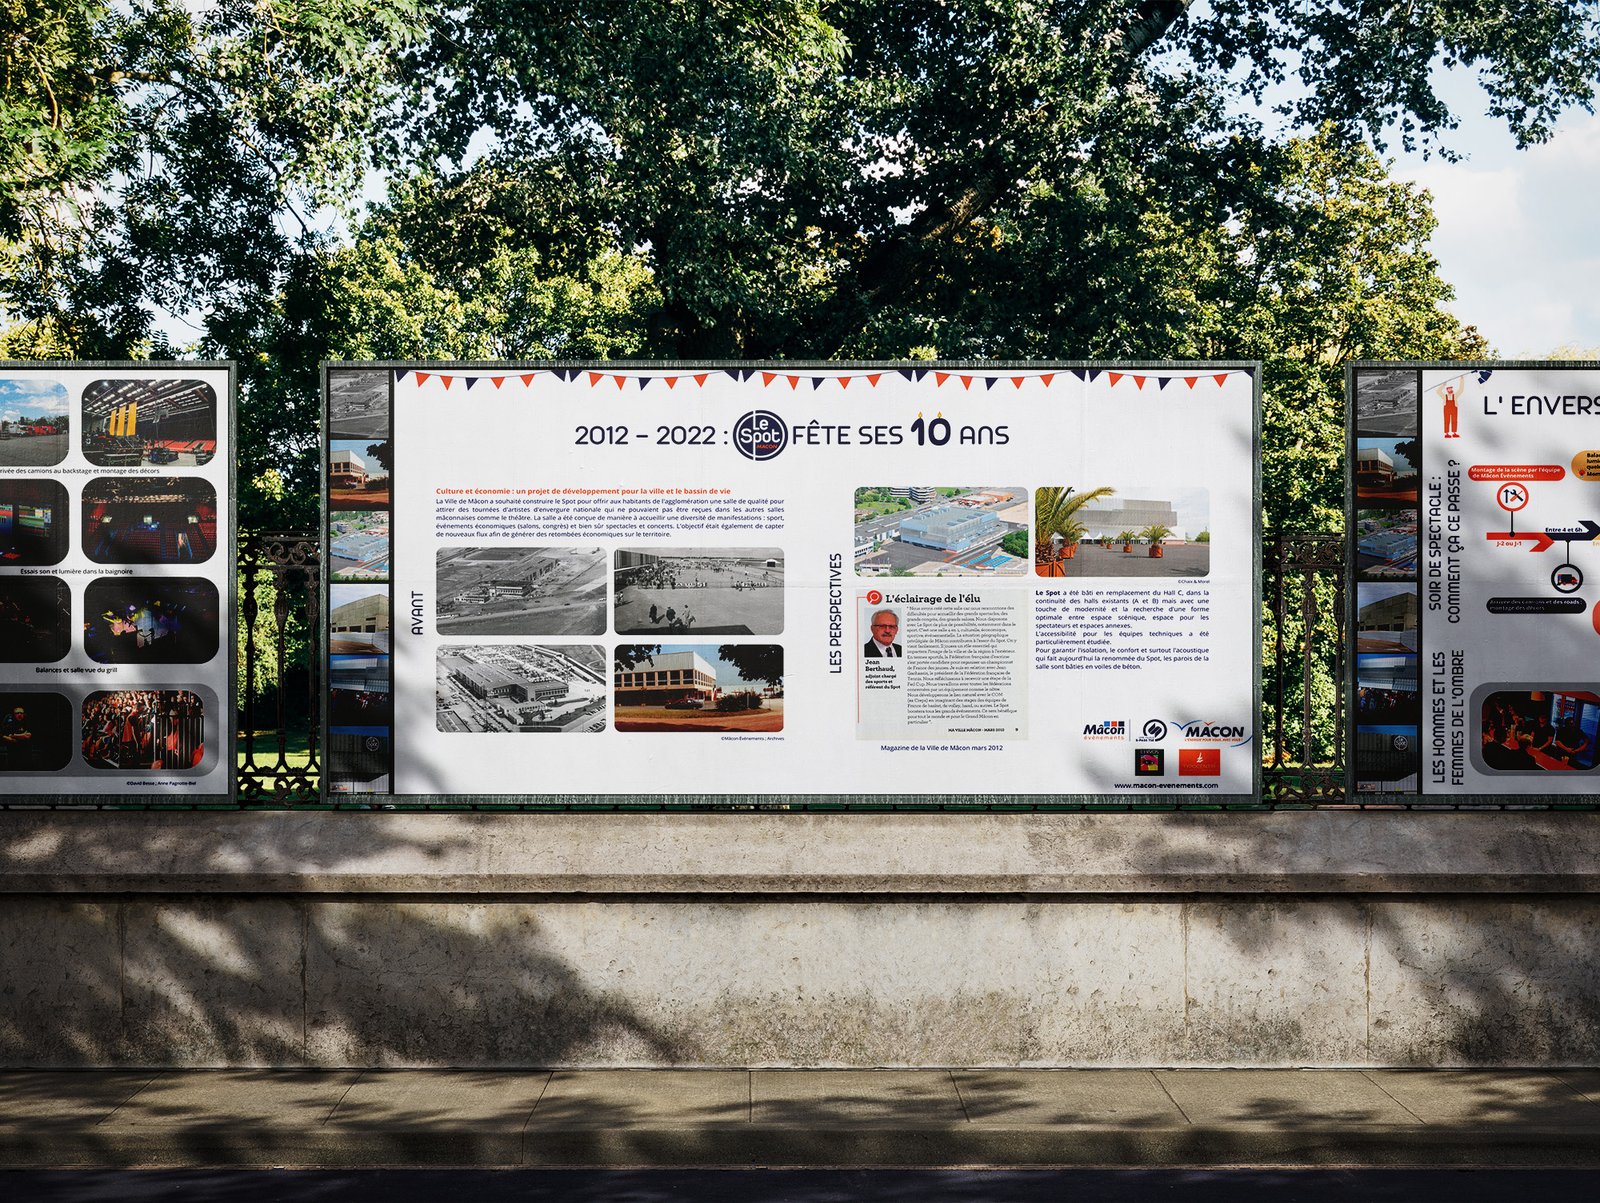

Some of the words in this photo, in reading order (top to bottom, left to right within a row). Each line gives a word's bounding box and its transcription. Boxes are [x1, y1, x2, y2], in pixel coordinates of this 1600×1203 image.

[575, 425, 629, 445] 2012
[656, 425, 716, 445] 2022
[740, 428, 781, 444] Spot
[753, 418, 769, 431] Le
[792, 420, 851, 445] FÊTE
[858, 425, 903, 445] SES
[910, 417, 951, 447] 10
[960, 425, 1010, 445] ANS
[1447, 470, 1460, 512] PASSE
[1429, 483, 1442, 557] SPECTACLE
[1447, 515, 1460, 532] CE
[1447, 534, 1465, 553] ÇA
[1429, 560, 1442, 577] DE
[829, 552, 842, 646] PERSPECTIVES
[885, 594, 942, 604] L'éclairage
[944, 593, 957, 603] de
[958, 593, 981, 603] l'élu
[1429, 581, 1442, 611] SOIR
[1447, 556, 1460, 624] COMMENT
[411, 590, 424, 636] AVANT
[829, 649, 842, 674] LES
[1432, 652, 1446, 675] LES
[1432, 678, 1446, 695] ET
[1451, 650, 1464, 707] L'OMBRE
[1083, 723, 1125, 735] Mâcon
[1432, 698, 1446, 756] HOMMES
[1451, 710, 1464, 727] DE
[1451, 730, 1464, 786] FEMMES
[1432, 759, 1446, 783] LES
